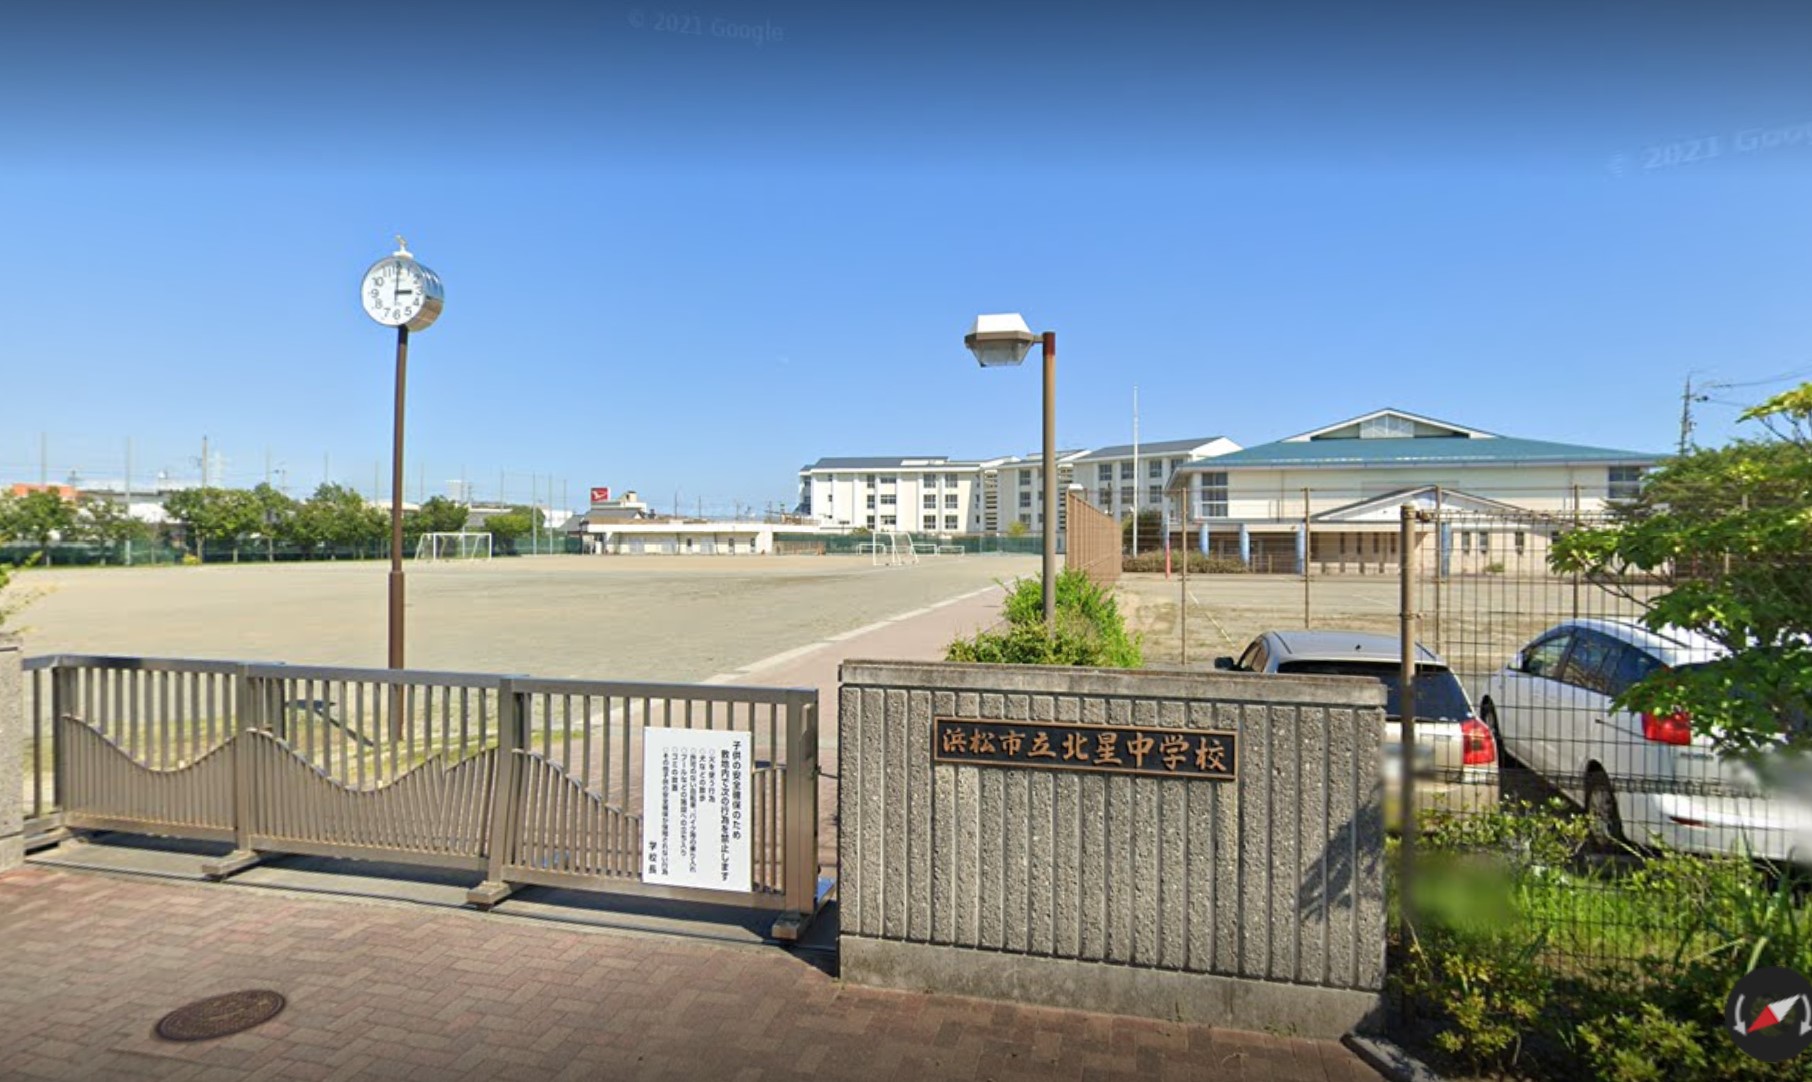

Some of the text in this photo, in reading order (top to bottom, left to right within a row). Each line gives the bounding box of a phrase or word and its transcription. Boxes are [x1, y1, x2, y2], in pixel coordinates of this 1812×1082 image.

[372, 277, 384, 287] 10
[371, 289, 379, 298] 9
[374, 299, 383, 309] 8
[383, 307, 391, 317] 7
[393, 309, 401, 320] 6
[404, 306, 412, 316] 5
[942, 727, 1227, 772] 浜松市立北星中学校
[732, 741, 742, 840] 子供の安全確保のため
